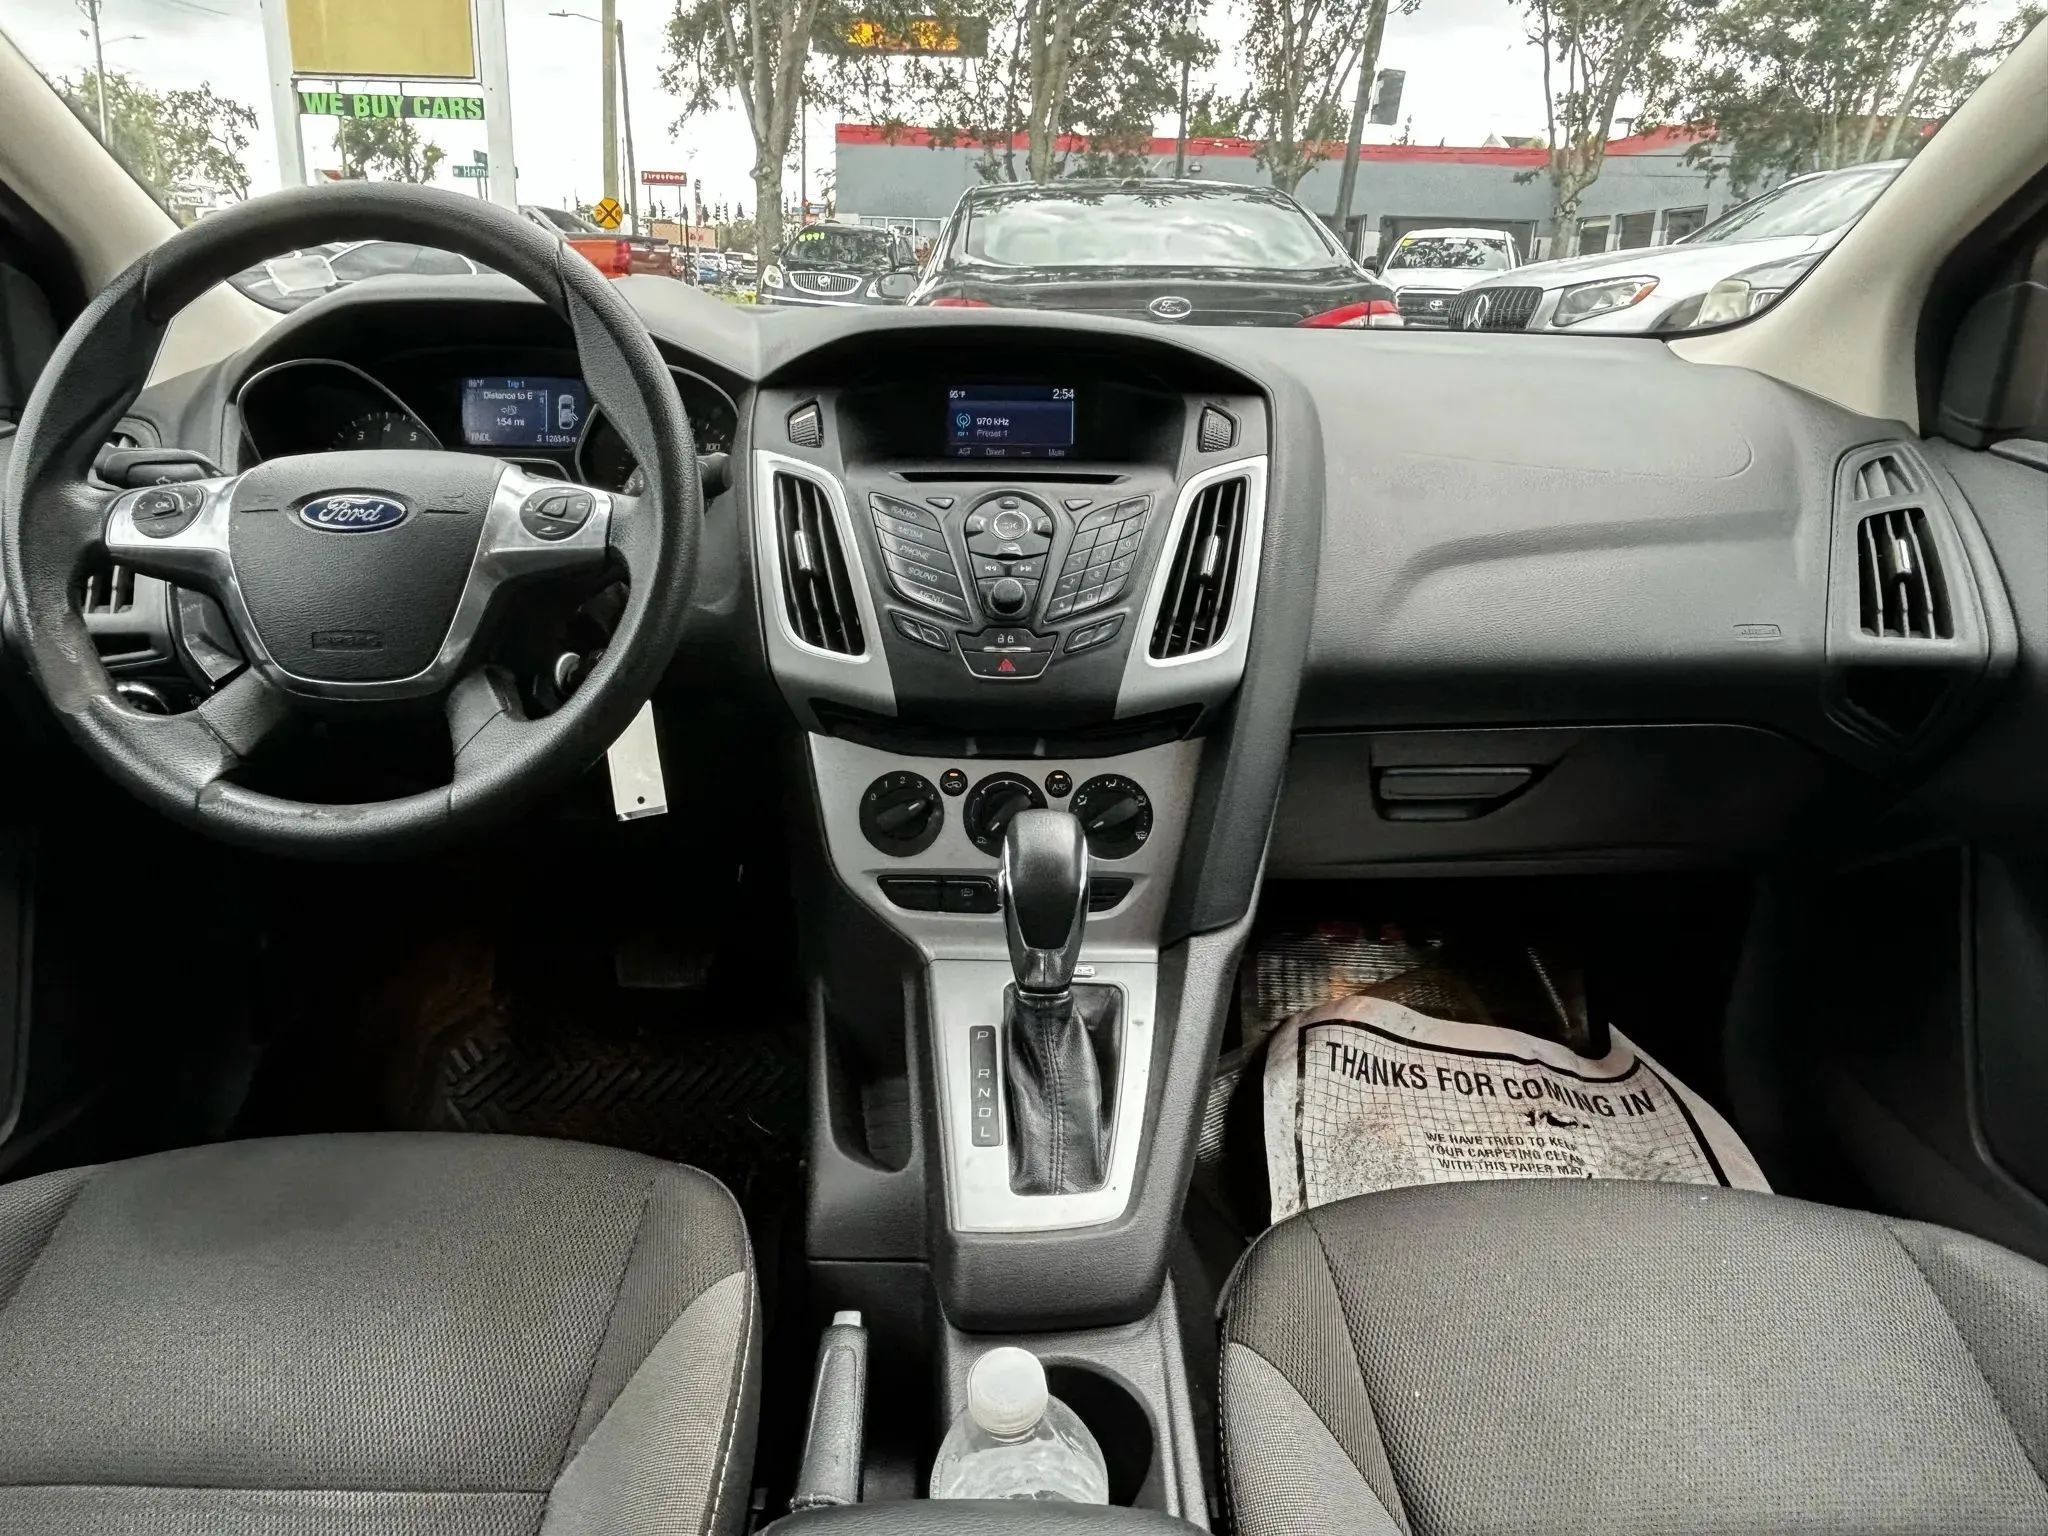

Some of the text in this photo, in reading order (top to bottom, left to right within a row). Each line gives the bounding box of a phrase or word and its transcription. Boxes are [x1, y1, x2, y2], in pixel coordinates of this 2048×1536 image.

[303, 93, 482, 119] WE BUY CARS
[483, 391, 533, 400] Distance to E
[1052, 388, 1074, 400] 2:54
[496, 417, 512, 426] 154
[976, 417, 992, 426] 970
[357, 423, 417, 441] 3 4 5
[705, 442, 721, 452] 100
[318, 497, 384, 522] Ford
[900, 545, 930, 560] PHONE
[908, 567, 938, 582] SOUND
[870, 793, 877, 801] 0
[900, 776, 906, 784] 2
[916, 781, 923, 789] 3
[977, 1030, 989, 1040] P
[978, 1068, 990, 1079] R
[1326, 1041, 1657, 1117] THANKS FOR COMING IN
[978, 1087, 991, 1098] N
[980, 1126, 991, 1137] L
[1424, 1132, 1446, 1143] WE
[1448, 1134, 1483, 1145] HAVE
[1485, 1136, 1525, 1146] TRIED
[1527, 1136, 1545, 1147] TO
[1426, 1143, 1465, 1157] YOUR
[1467, 1147, 1542, 1160] CARPETING
[1437, 1158, 1583, 1176] WITH THIS PAPER MAT
